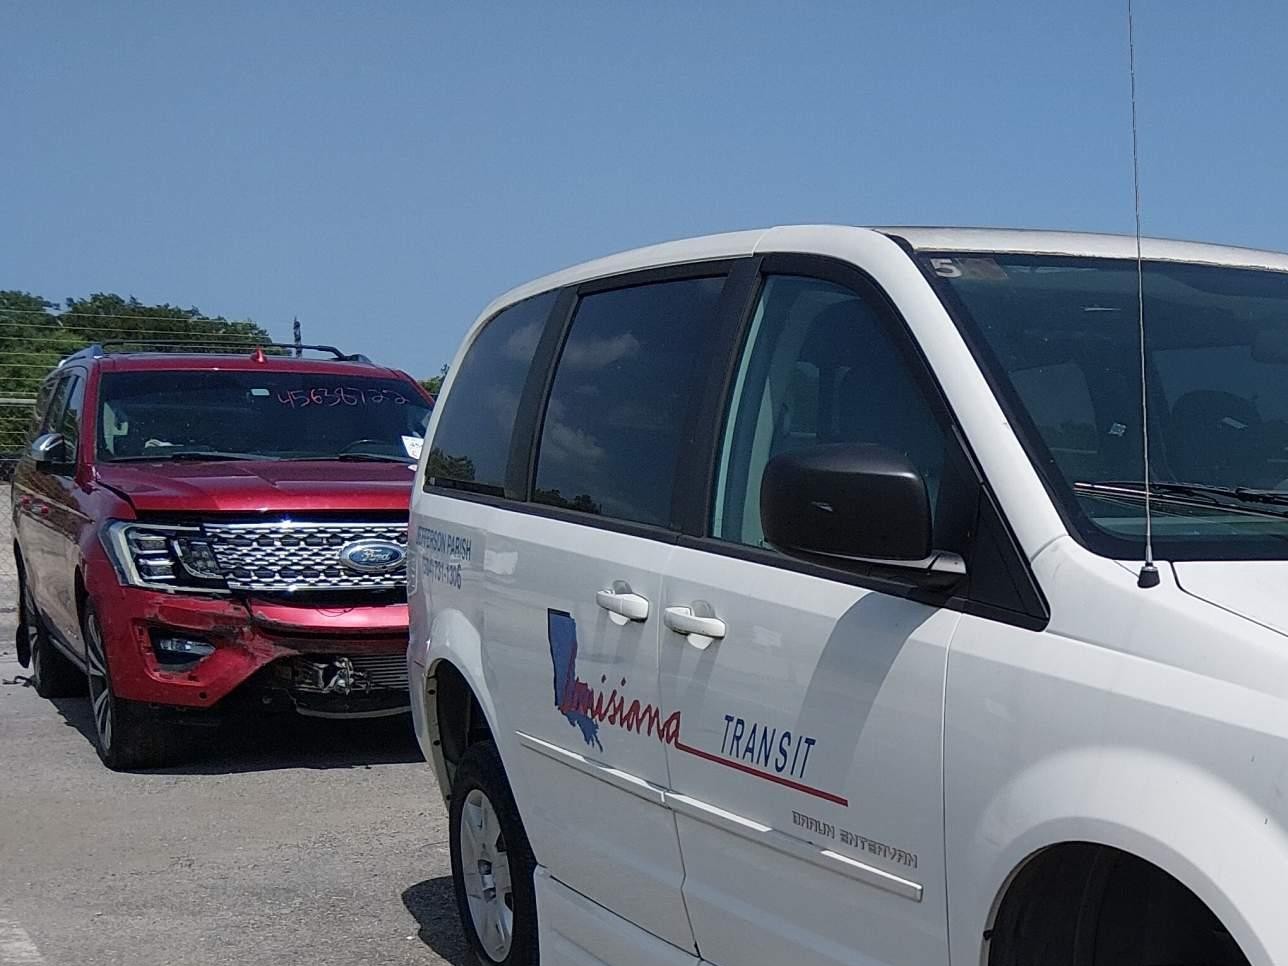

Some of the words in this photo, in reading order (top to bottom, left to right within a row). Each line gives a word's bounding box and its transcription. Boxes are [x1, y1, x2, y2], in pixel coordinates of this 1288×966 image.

[447, 534, 472, 561] PARISH
[720, 714, 817, 778] TRANSIT
[791, 810, 836, 840] BRAUN
[839, 828, 919, 869] ENTERVAN
